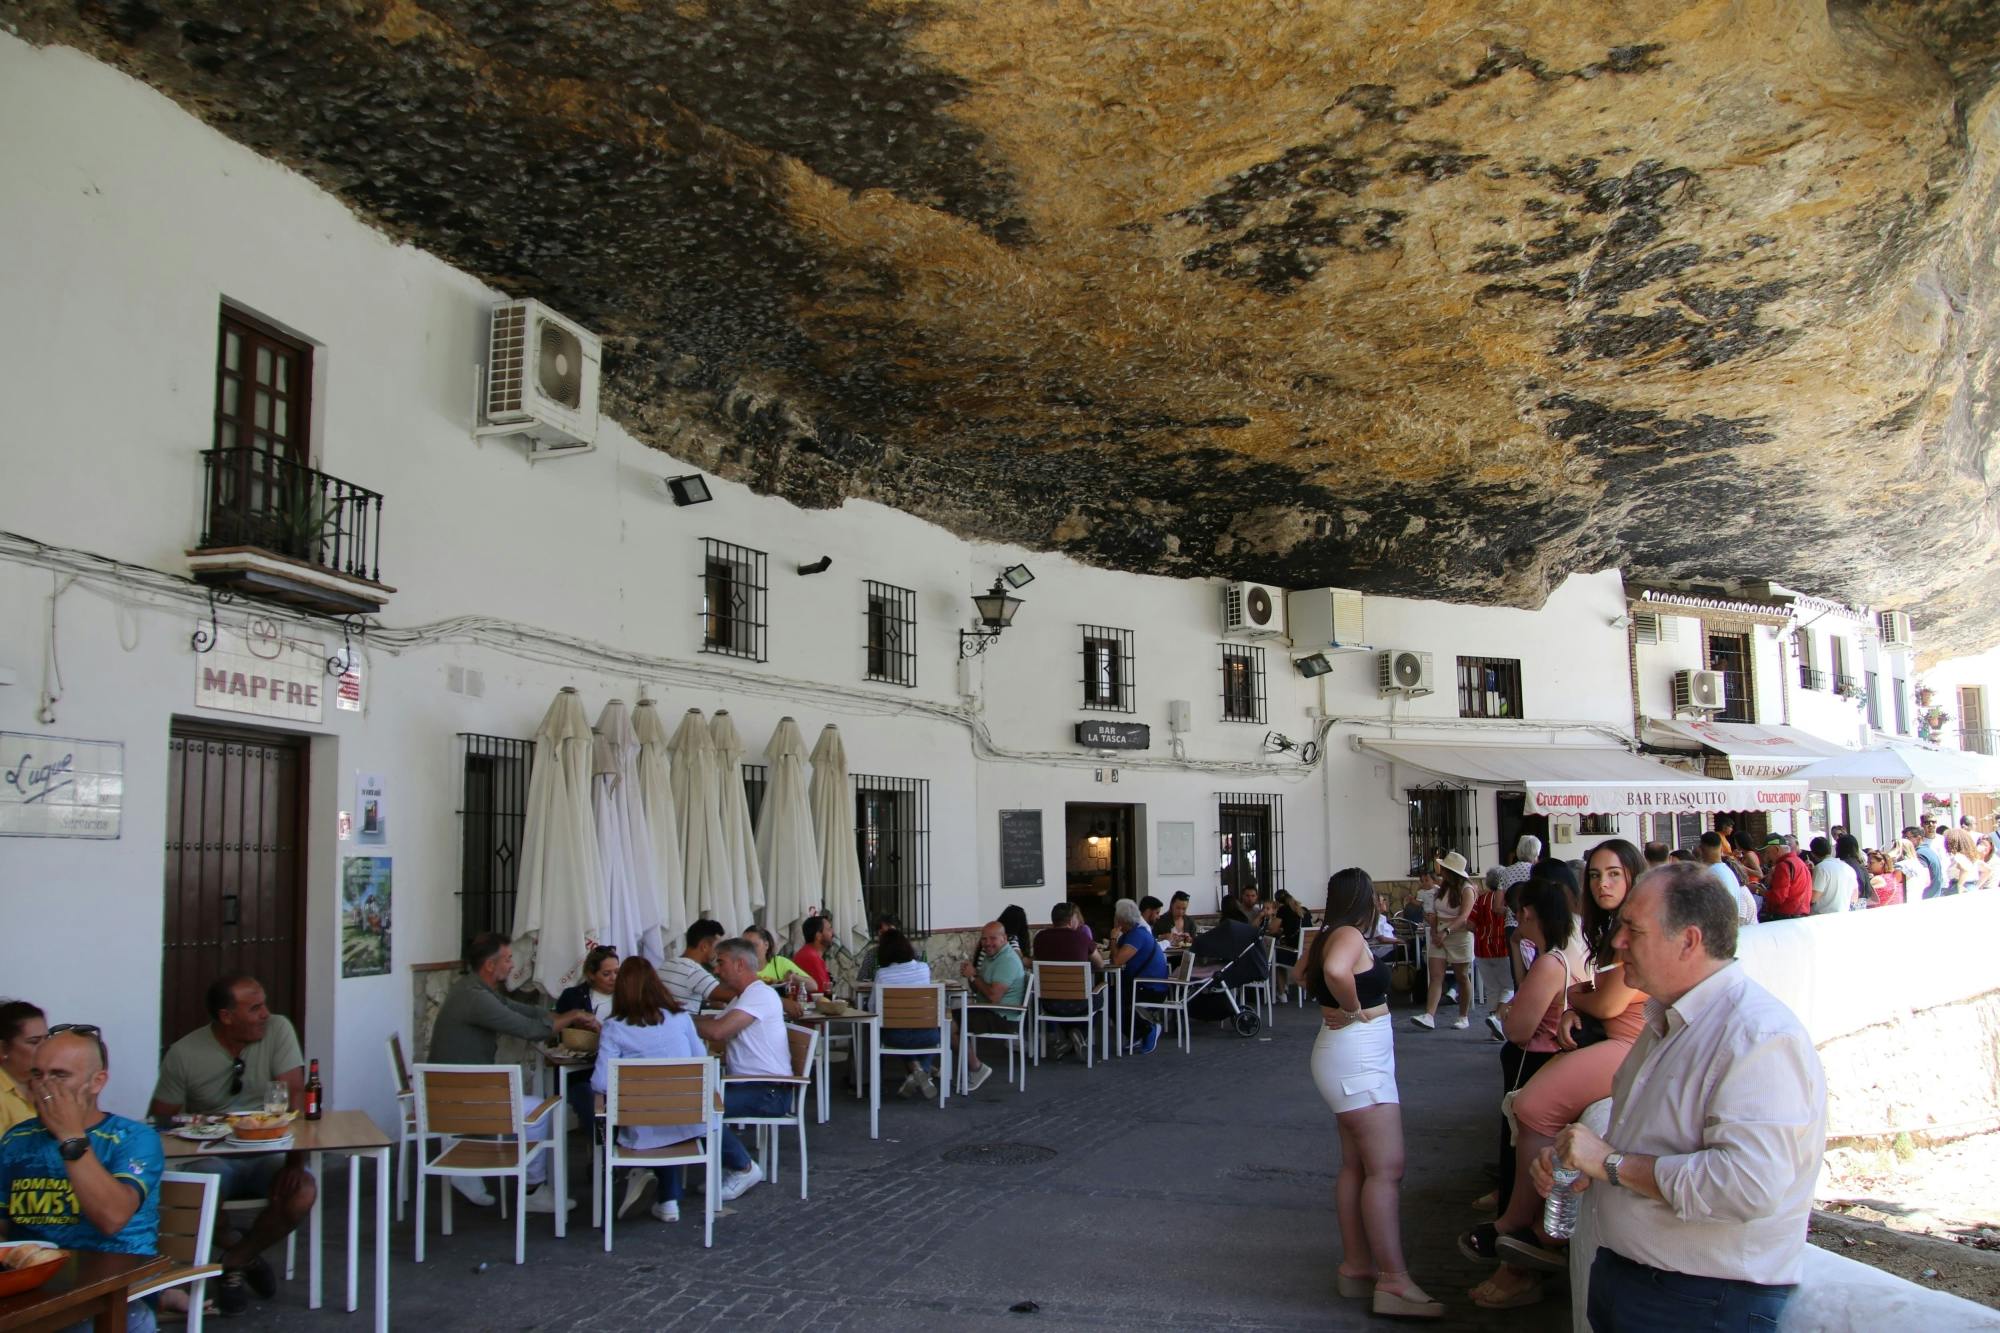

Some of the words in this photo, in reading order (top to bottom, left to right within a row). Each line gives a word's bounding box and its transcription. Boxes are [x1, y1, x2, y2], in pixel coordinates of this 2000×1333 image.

[203, 667, 319, 707] MAPFRE
[1099, 726, 1115, 735] BAR
[1088, 734, 1098, 742] LA
[1101, 735, 1126, 744] TASCA
[1536, 791, 1589, 808] Cruzcampo
[1627, 791, 1652, 805] BAR
[1655, 791, 1726, 808] FRASQUITO
[1757, 790, 1801, 805] Cruzcampo
[12, 1178, 74, 1193] HOMENAJ
[9, 1191, 80, 1216] KM51
